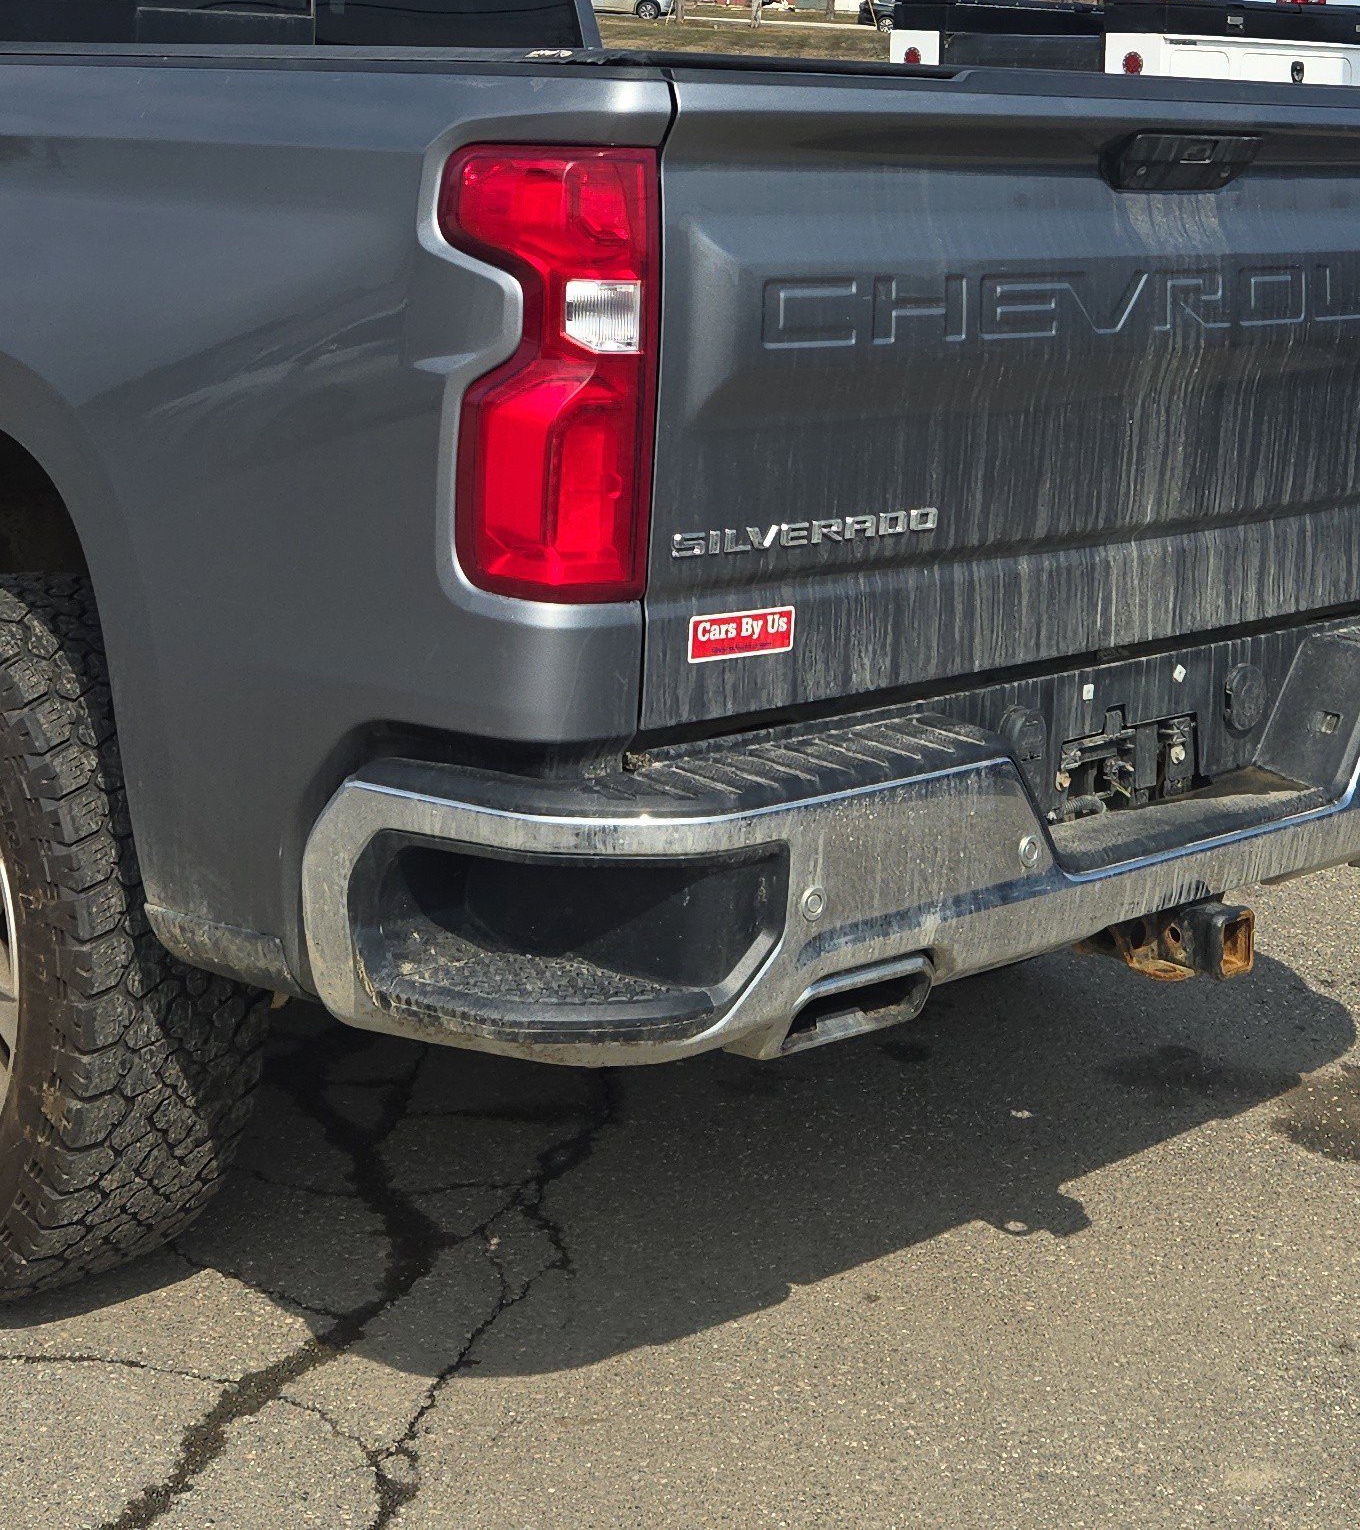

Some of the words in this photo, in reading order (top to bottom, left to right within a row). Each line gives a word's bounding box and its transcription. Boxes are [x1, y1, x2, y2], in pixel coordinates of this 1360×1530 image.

[671, 506, 939, 558] SILVERADO
[697, 621, 737, 642] Cars
[741, 617, 764, 640] By
[766, 614, 788, 634] Us
